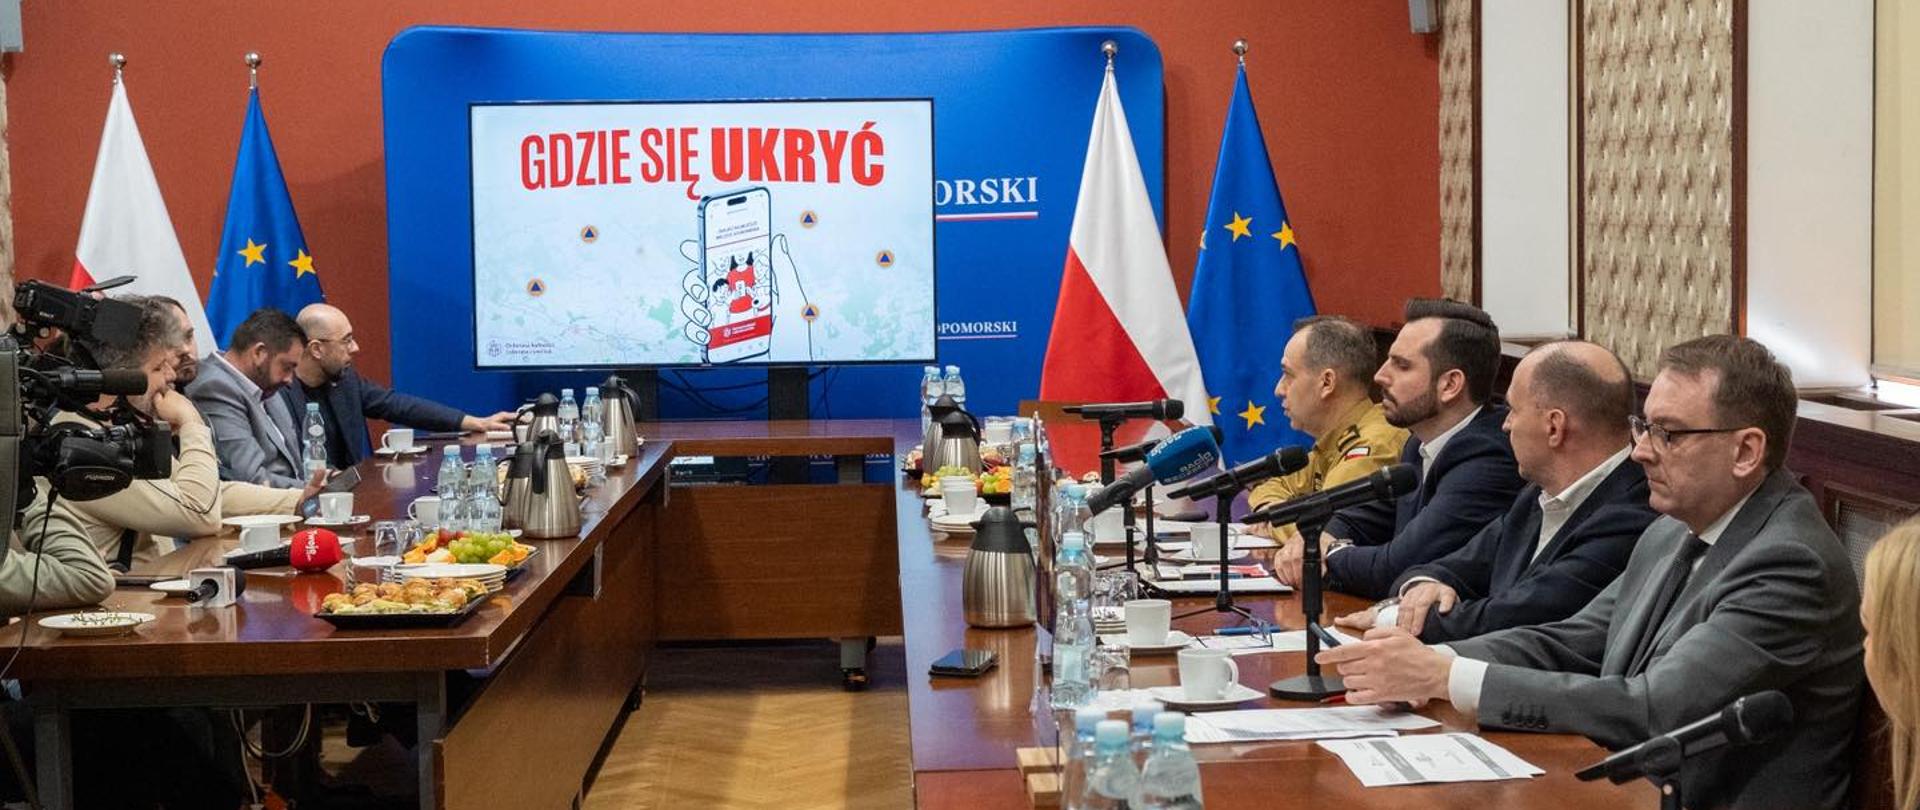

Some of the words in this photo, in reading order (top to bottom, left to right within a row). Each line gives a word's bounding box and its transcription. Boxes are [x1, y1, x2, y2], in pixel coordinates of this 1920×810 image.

[521, 130, 632, 191] GDZIE
[640, 127, 701, 200] SIĘ
[711, 121, 885, 187] UKRYĆ
[938, 321, 1017, 334] POMORSKI
